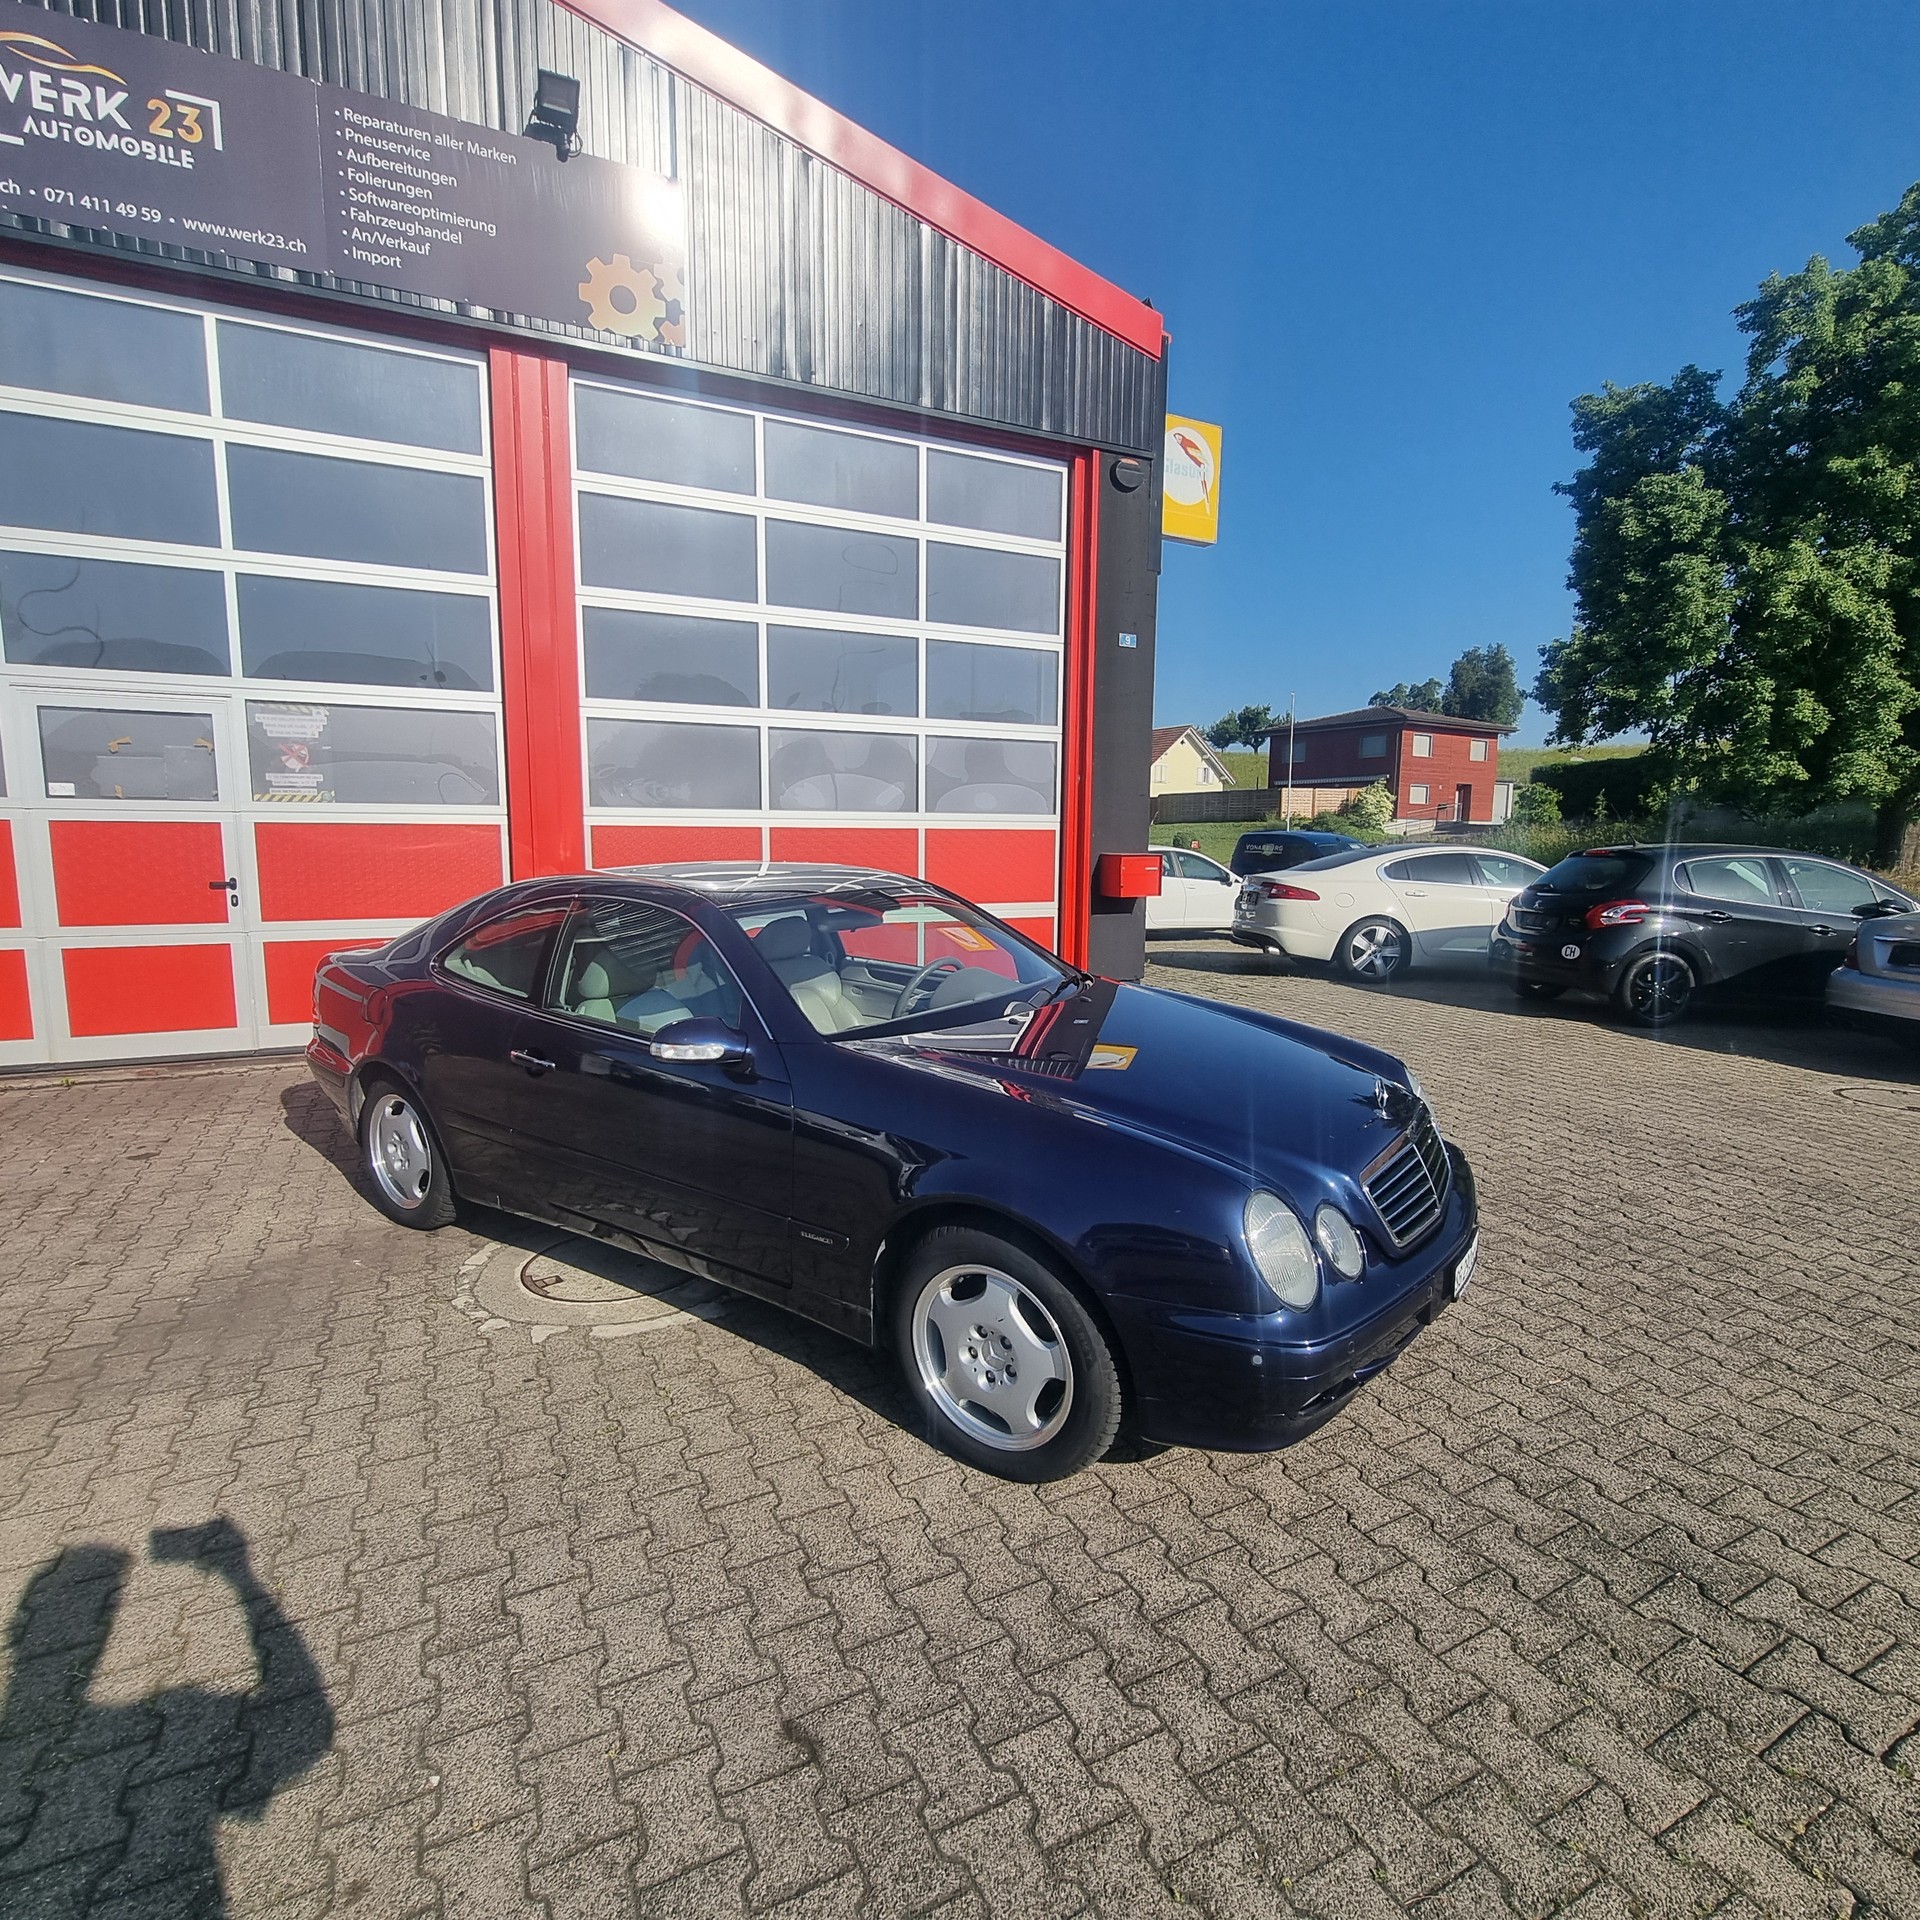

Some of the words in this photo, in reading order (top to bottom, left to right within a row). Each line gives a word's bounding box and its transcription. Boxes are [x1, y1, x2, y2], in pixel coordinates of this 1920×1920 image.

[147, 99, 203, 143] 23
[343, 107, 431, 143] Reparaturen
[434, 133, 464, 151] aller
[467, 140, 517, 165] Marken
[22, 115, 195, 169] AUTOMOBILE
[345, 127, 431, 161] Pneuservice
[346, 148, 457, 188] Aufbereitungen
[347, 167, 433, 200] Folierungen
[43, 187, 75, 206] 071
[80, 195, 110, 213] 411
[115, 202, 138, 218] 49
[140, 207, 162, 223] 59
[182, 218, 307, 253] www.werk23.ch
[348, 187, 497, 237] Softwareoptimierung
[350, 206, 463, 245] Fahrzeughandel
[351, 226, 431, 256] An/Verkauf
[352, 246, 402, 268] Import
[1564, 946, 1576, 957] CH
